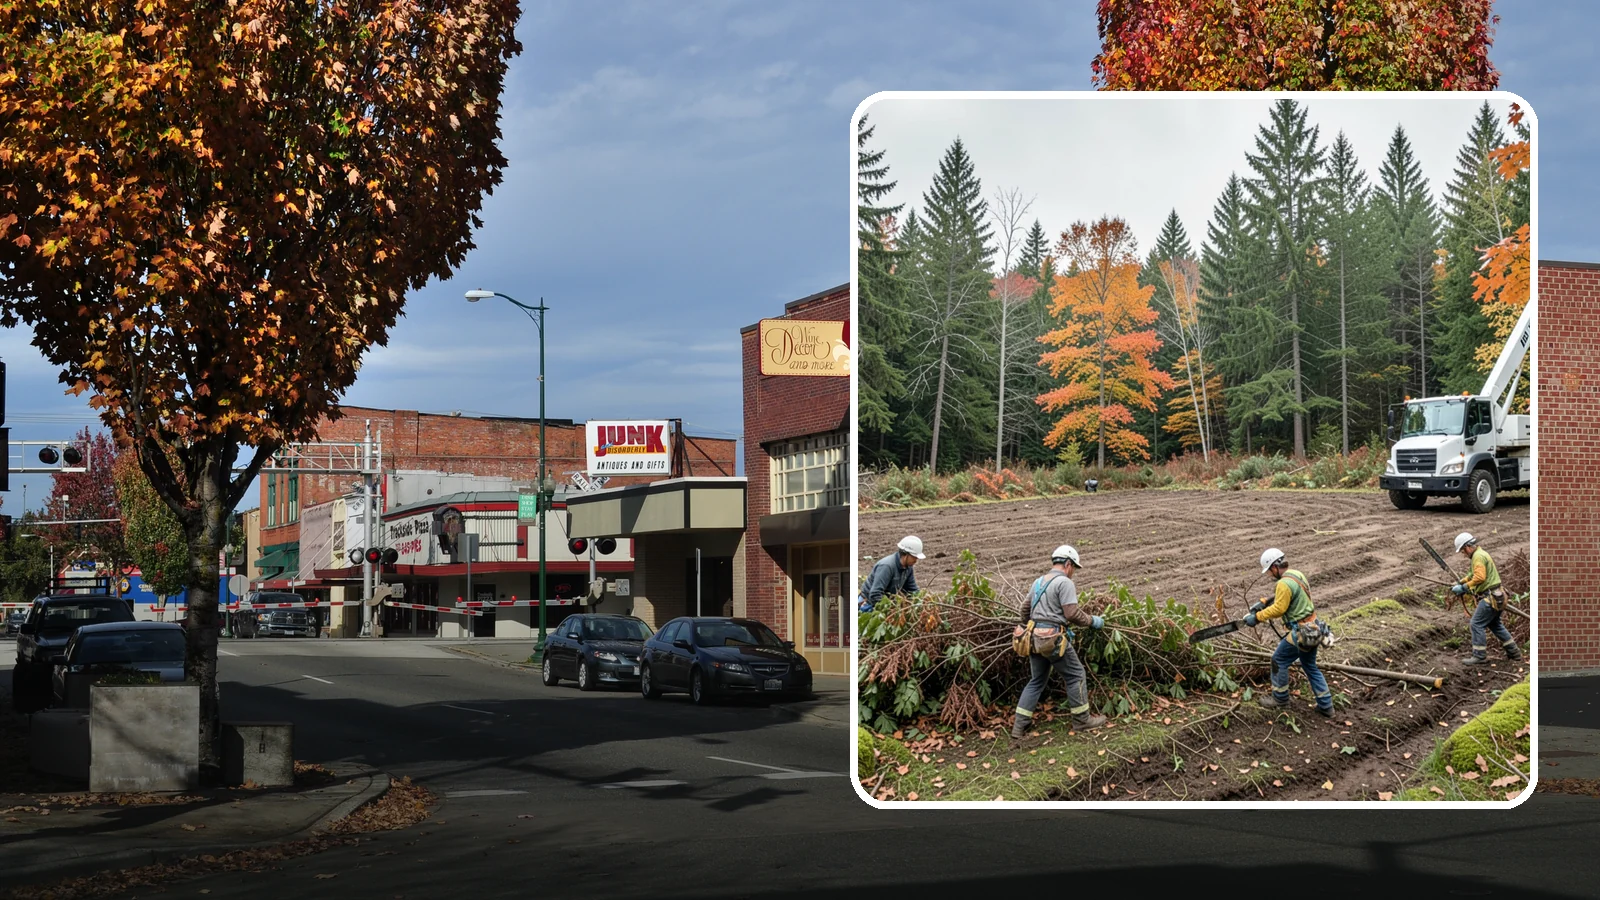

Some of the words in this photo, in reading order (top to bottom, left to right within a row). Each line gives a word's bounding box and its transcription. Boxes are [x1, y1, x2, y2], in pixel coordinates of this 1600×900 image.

[596, 426, 664, 456] JUNK
[607, 446, 646, 454] DISORDERLY
[597, 461, 628, 470] ANTIQUES
[631, 461, 644, 470] AND
[647, 460, 665, 469] GIFTS
[590, 475, 609, 492] SING
[352, 498, 365, 511] CRO
